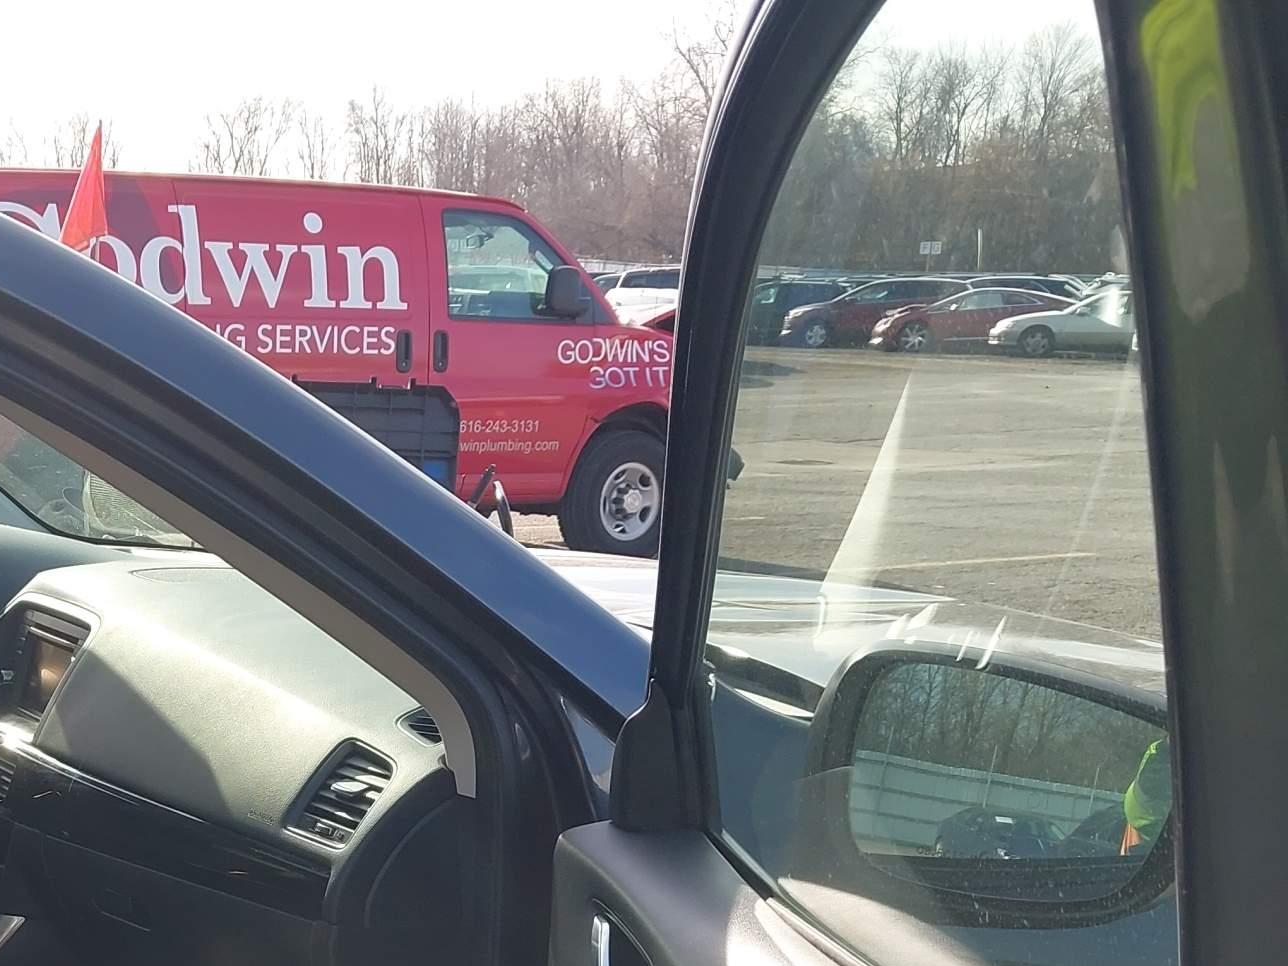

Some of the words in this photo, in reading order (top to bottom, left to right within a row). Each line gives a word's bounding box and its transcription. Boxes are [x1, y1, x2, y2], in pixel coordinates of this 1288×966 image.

[257, 324, 396, 354] SERVICES
[557, 338, 670, 364] GODWIN'S
[645, 367, 669, 388] IT
[459, 420, 539, 433] 616-243-3131
